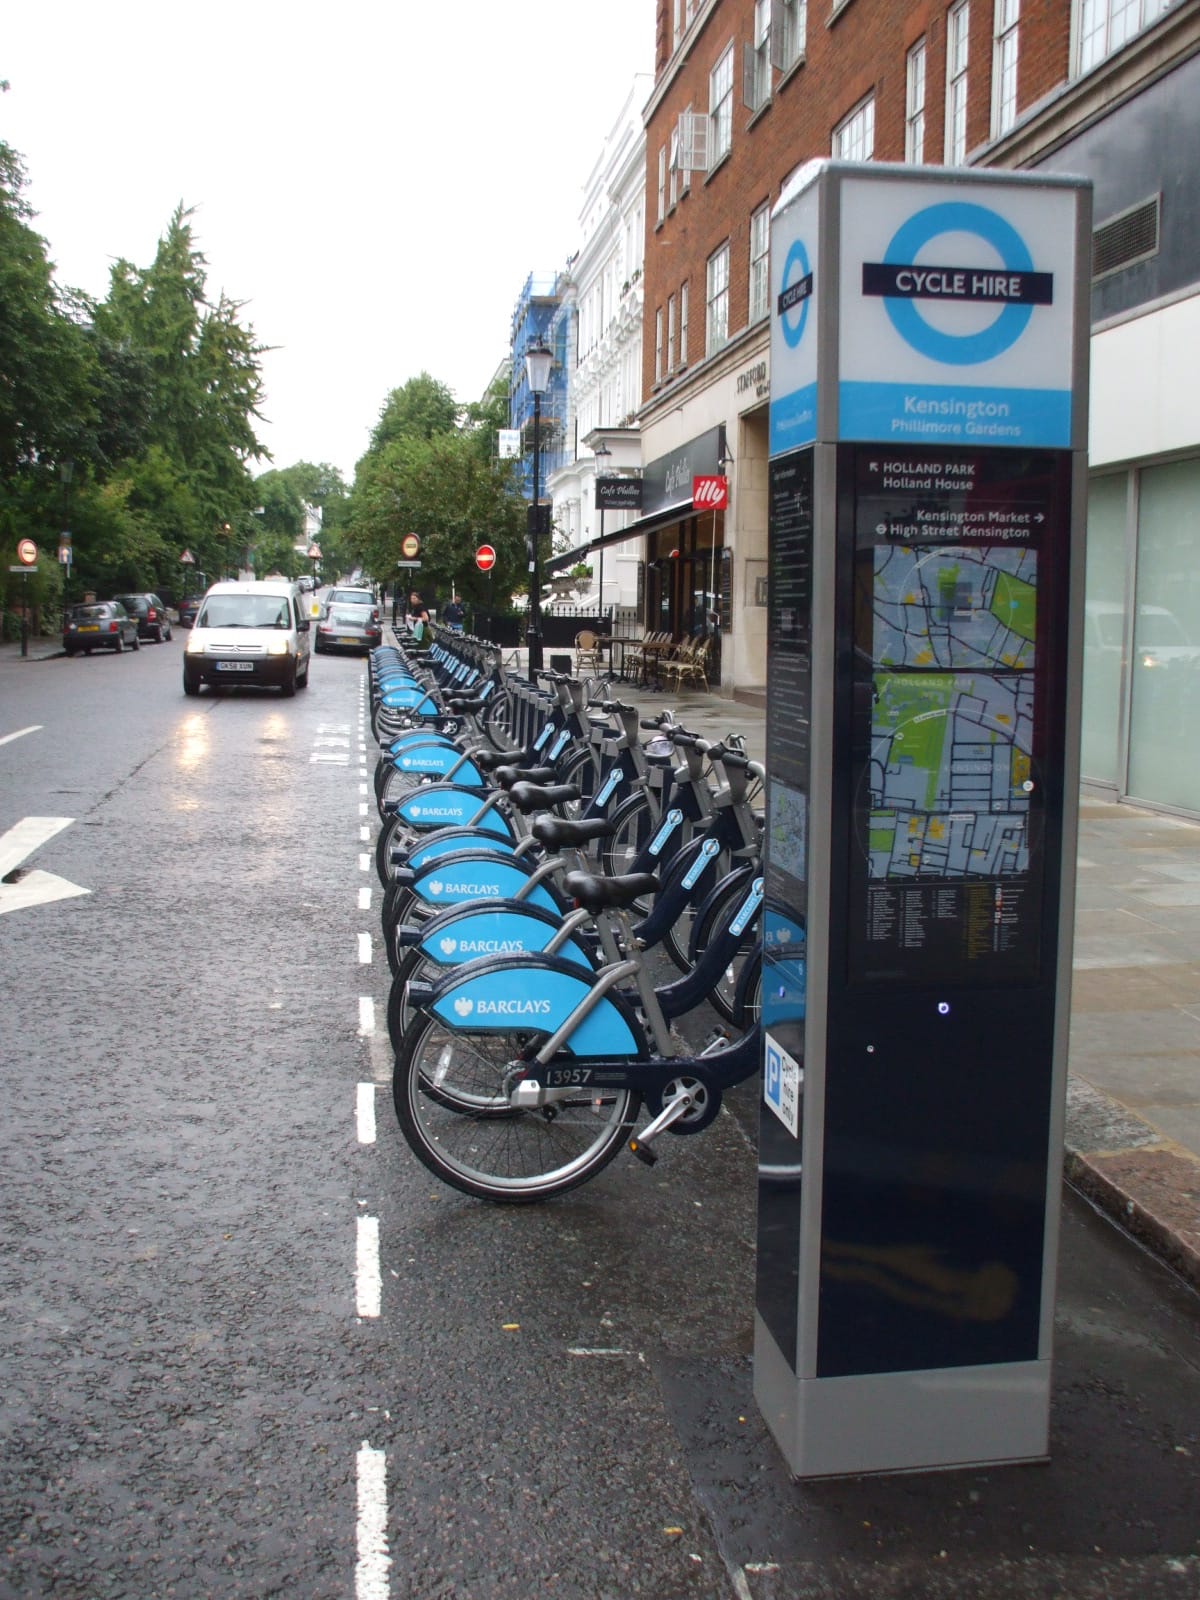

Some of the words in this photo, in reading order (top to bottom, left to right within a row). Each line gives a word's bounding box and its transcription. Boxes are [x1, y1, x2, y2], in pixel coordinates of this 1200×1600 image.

[895, 271, 966, 294] CYCLE
[972, 275, 1021, 297] HIRE
[904, 395, 1010, 419] Kensington
[891, 418, 961, 434] Phillimore
[965, 421, 1022, 437] Gardens
[883, 462, 942, 474] HOLLAND
[945, 464, 975, 475] PARK
[883, 477, 931, 489] Holland
[935, 479, 974, 490] House
[600, 485, 616, 497] Cafe
[694, 480, 725, 507] illy
[917, 510, 985, 524] Kensington
[989, 512, 1030, 523] Market
[890, 524, 918, 537] High
[922, 525, 960, 537] Street
[963, 526, 1030, 540] Kensington
[412, 759, 444, 768] BARCLAYS
[421, 807, 463, 817] BARCLAYS
[445, 882, 499, 896] BARCLAYS
[459, 940, 523, 952] BARCLAYS
[477, 1000, 550, 1015] BARCLAYS
[546, 1069, 592, 1085] 13957
[768, 1052, 778, 1093] P
